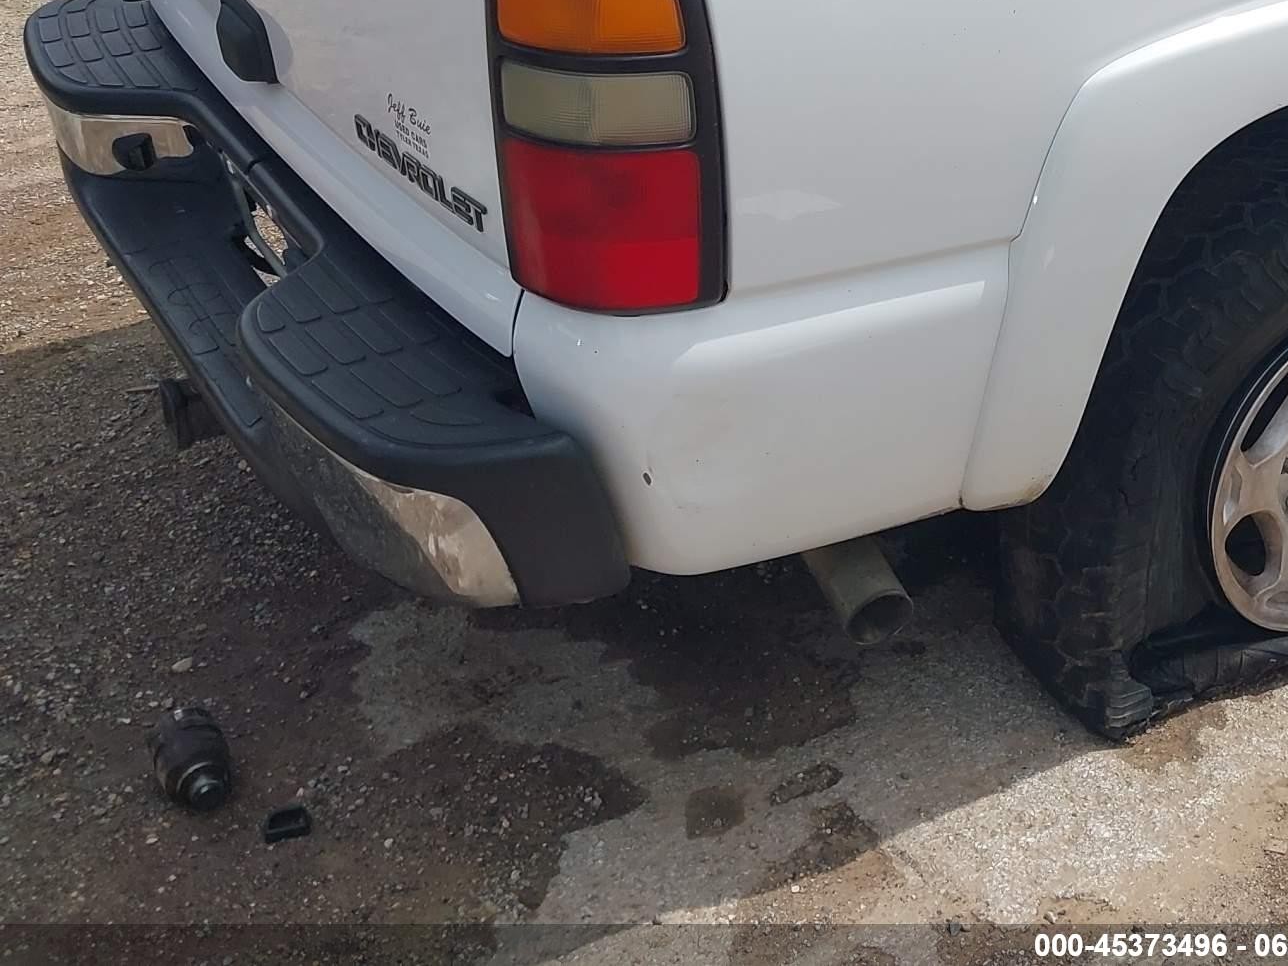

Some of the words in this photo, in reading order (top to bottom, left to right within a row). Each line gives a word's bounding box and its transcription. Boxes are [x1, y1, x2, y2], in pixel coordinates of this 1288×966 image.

[387, 92, 406, 124] Jeff
[408, 107, 432, 135] Buie
[394, 120, 410, 137] USED
[410, 131, 428, 149] CARS
[354, 113, 488, 233] CHEVROLET
